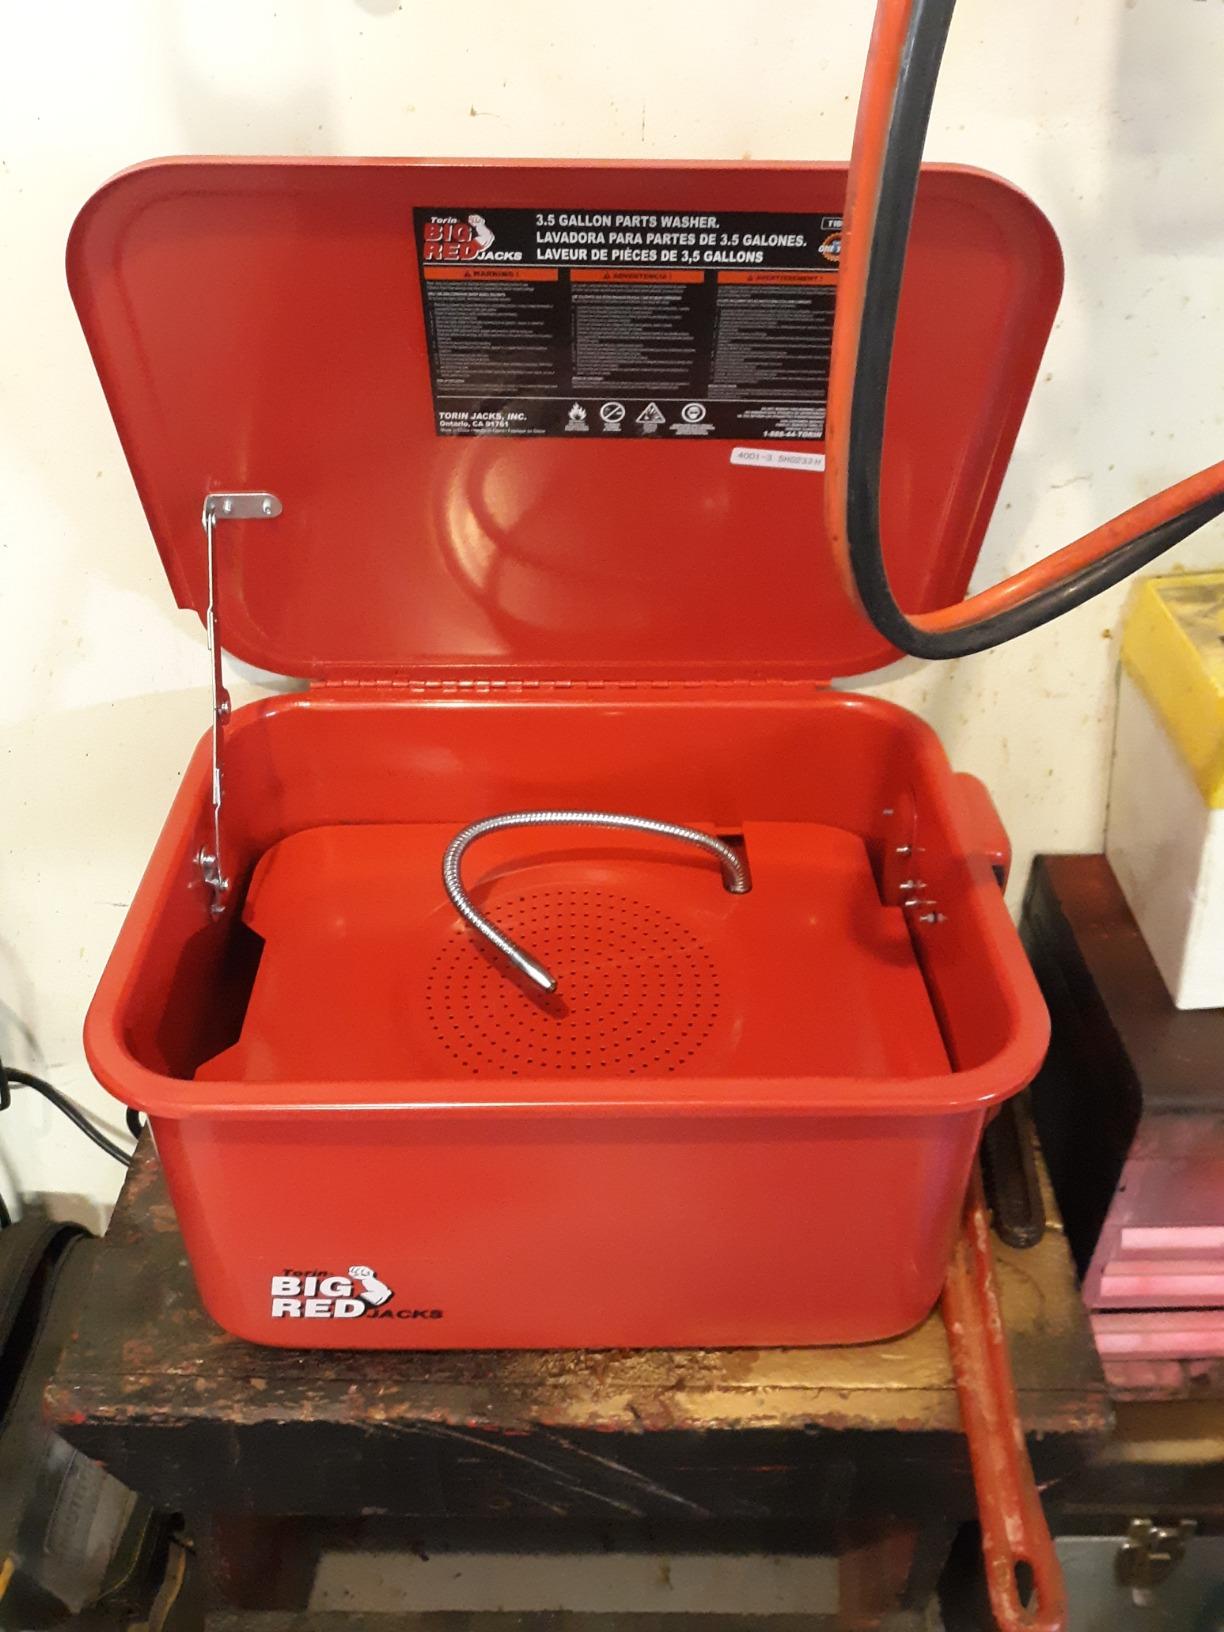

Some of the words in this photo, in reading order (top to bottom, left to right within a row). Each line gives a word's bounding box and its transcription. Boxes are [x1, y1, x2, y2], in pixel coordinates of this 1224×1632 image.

[431, 216, 458, 224] Torin
[536, 214, 555, 226] 3.5
[559, 214, 611, 227] GALLON
[615, 215, 657, 228] PARTS
[660, 216, 720, 229] WASHER.
[424, 223, 473, 242] BIG
[536, 231, 605, 244] LAVADORA
[609, 232, 643, 244] PARA
[646, 233, 695, 245] PARTES
[699, 234, 717, 245] DE
[719, 234, 739, 246] 3.5
[742, 234, 807, 247] GALONES.
[424, 241, 479, 260] RED
[477, 251, 523, 261] JACKS
[537, 248, 587, 260] LAVEUR
[591, 249, 608, 260] DE
[611, 246, 657, 261] PIÈCES
[660, 249, 678, 261] DE
[681, 250, 700, 264] 3,5
[703, 251, 764, 263] GALLONS
[473, 270, 514, 278] WARNING
[439, 411, 469, 420] TORIN
[470, 412, 505, 421] JACKS,
[507, 412, 527, 421] INC.
[439, 420, 471, 428] Ontario,
[472, 420, 484, 428] CA
[282, 1268, 328, 1277] Torin
[271, 1275, 354, 1298] BIG
[271, 1298, 367, 1318] RED
[366, 1308, 444, 1319] JACKS
